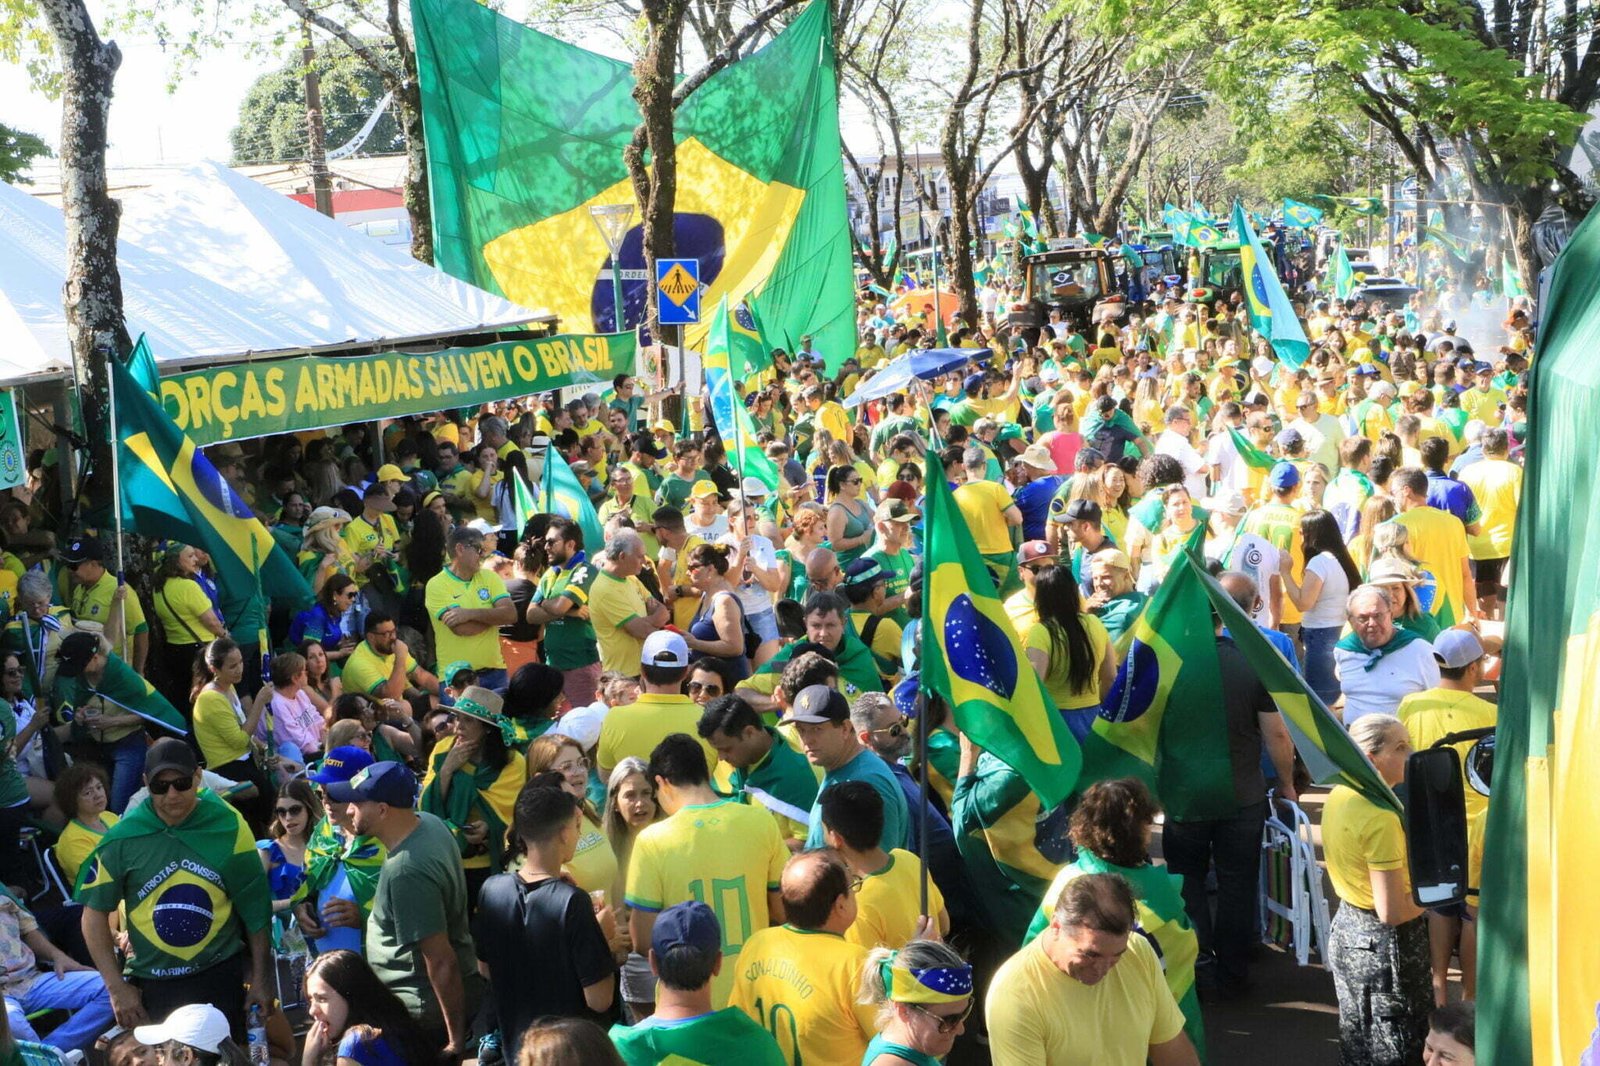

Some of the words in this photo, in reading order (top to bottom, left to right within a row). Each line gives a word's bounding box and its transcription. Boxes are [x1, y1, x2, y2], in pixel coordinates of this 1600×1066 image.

[148, 367, 286, 438] ORÇAS
[295, 357, 424, 413] ARMADAS
[425, 349, 513, 396] SALVEM
[513, 345, 538, 382] O
[536, 336, 614, 378] BRASIL
[137, 861, 179, 900] PATRIOTAS
